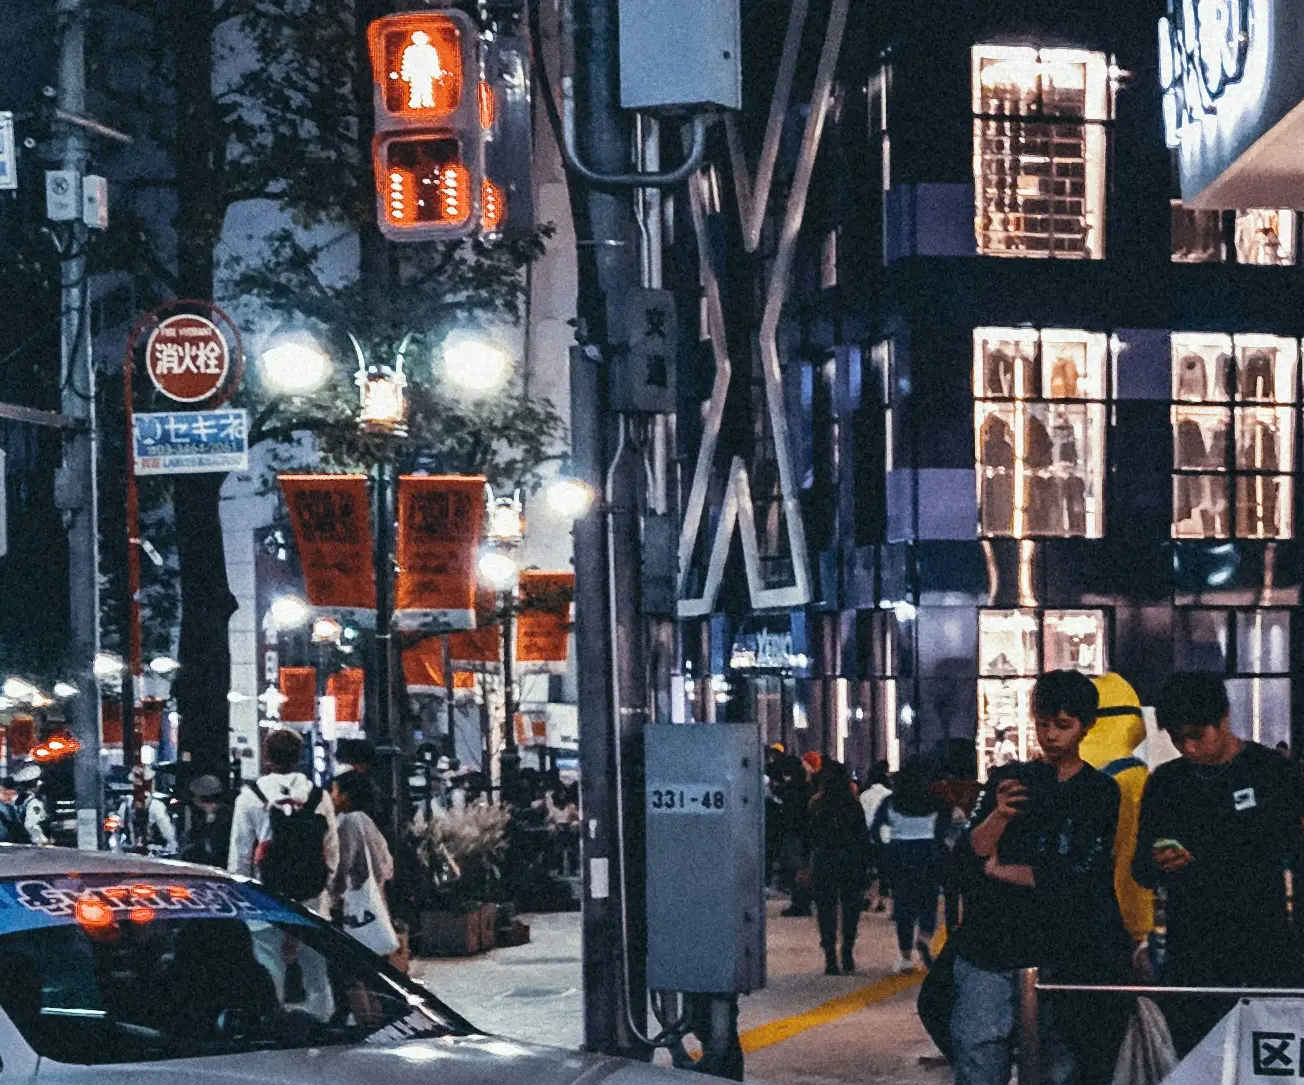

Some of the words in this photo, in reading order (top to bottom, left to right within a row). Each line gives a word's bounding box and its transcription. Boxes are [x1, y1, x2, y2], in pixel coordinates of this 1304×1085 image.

[154, 341, 222, 375] 消火栓
[164, 414, 246, 444] セキネ
[651, 789, 725, 810] 331-48
